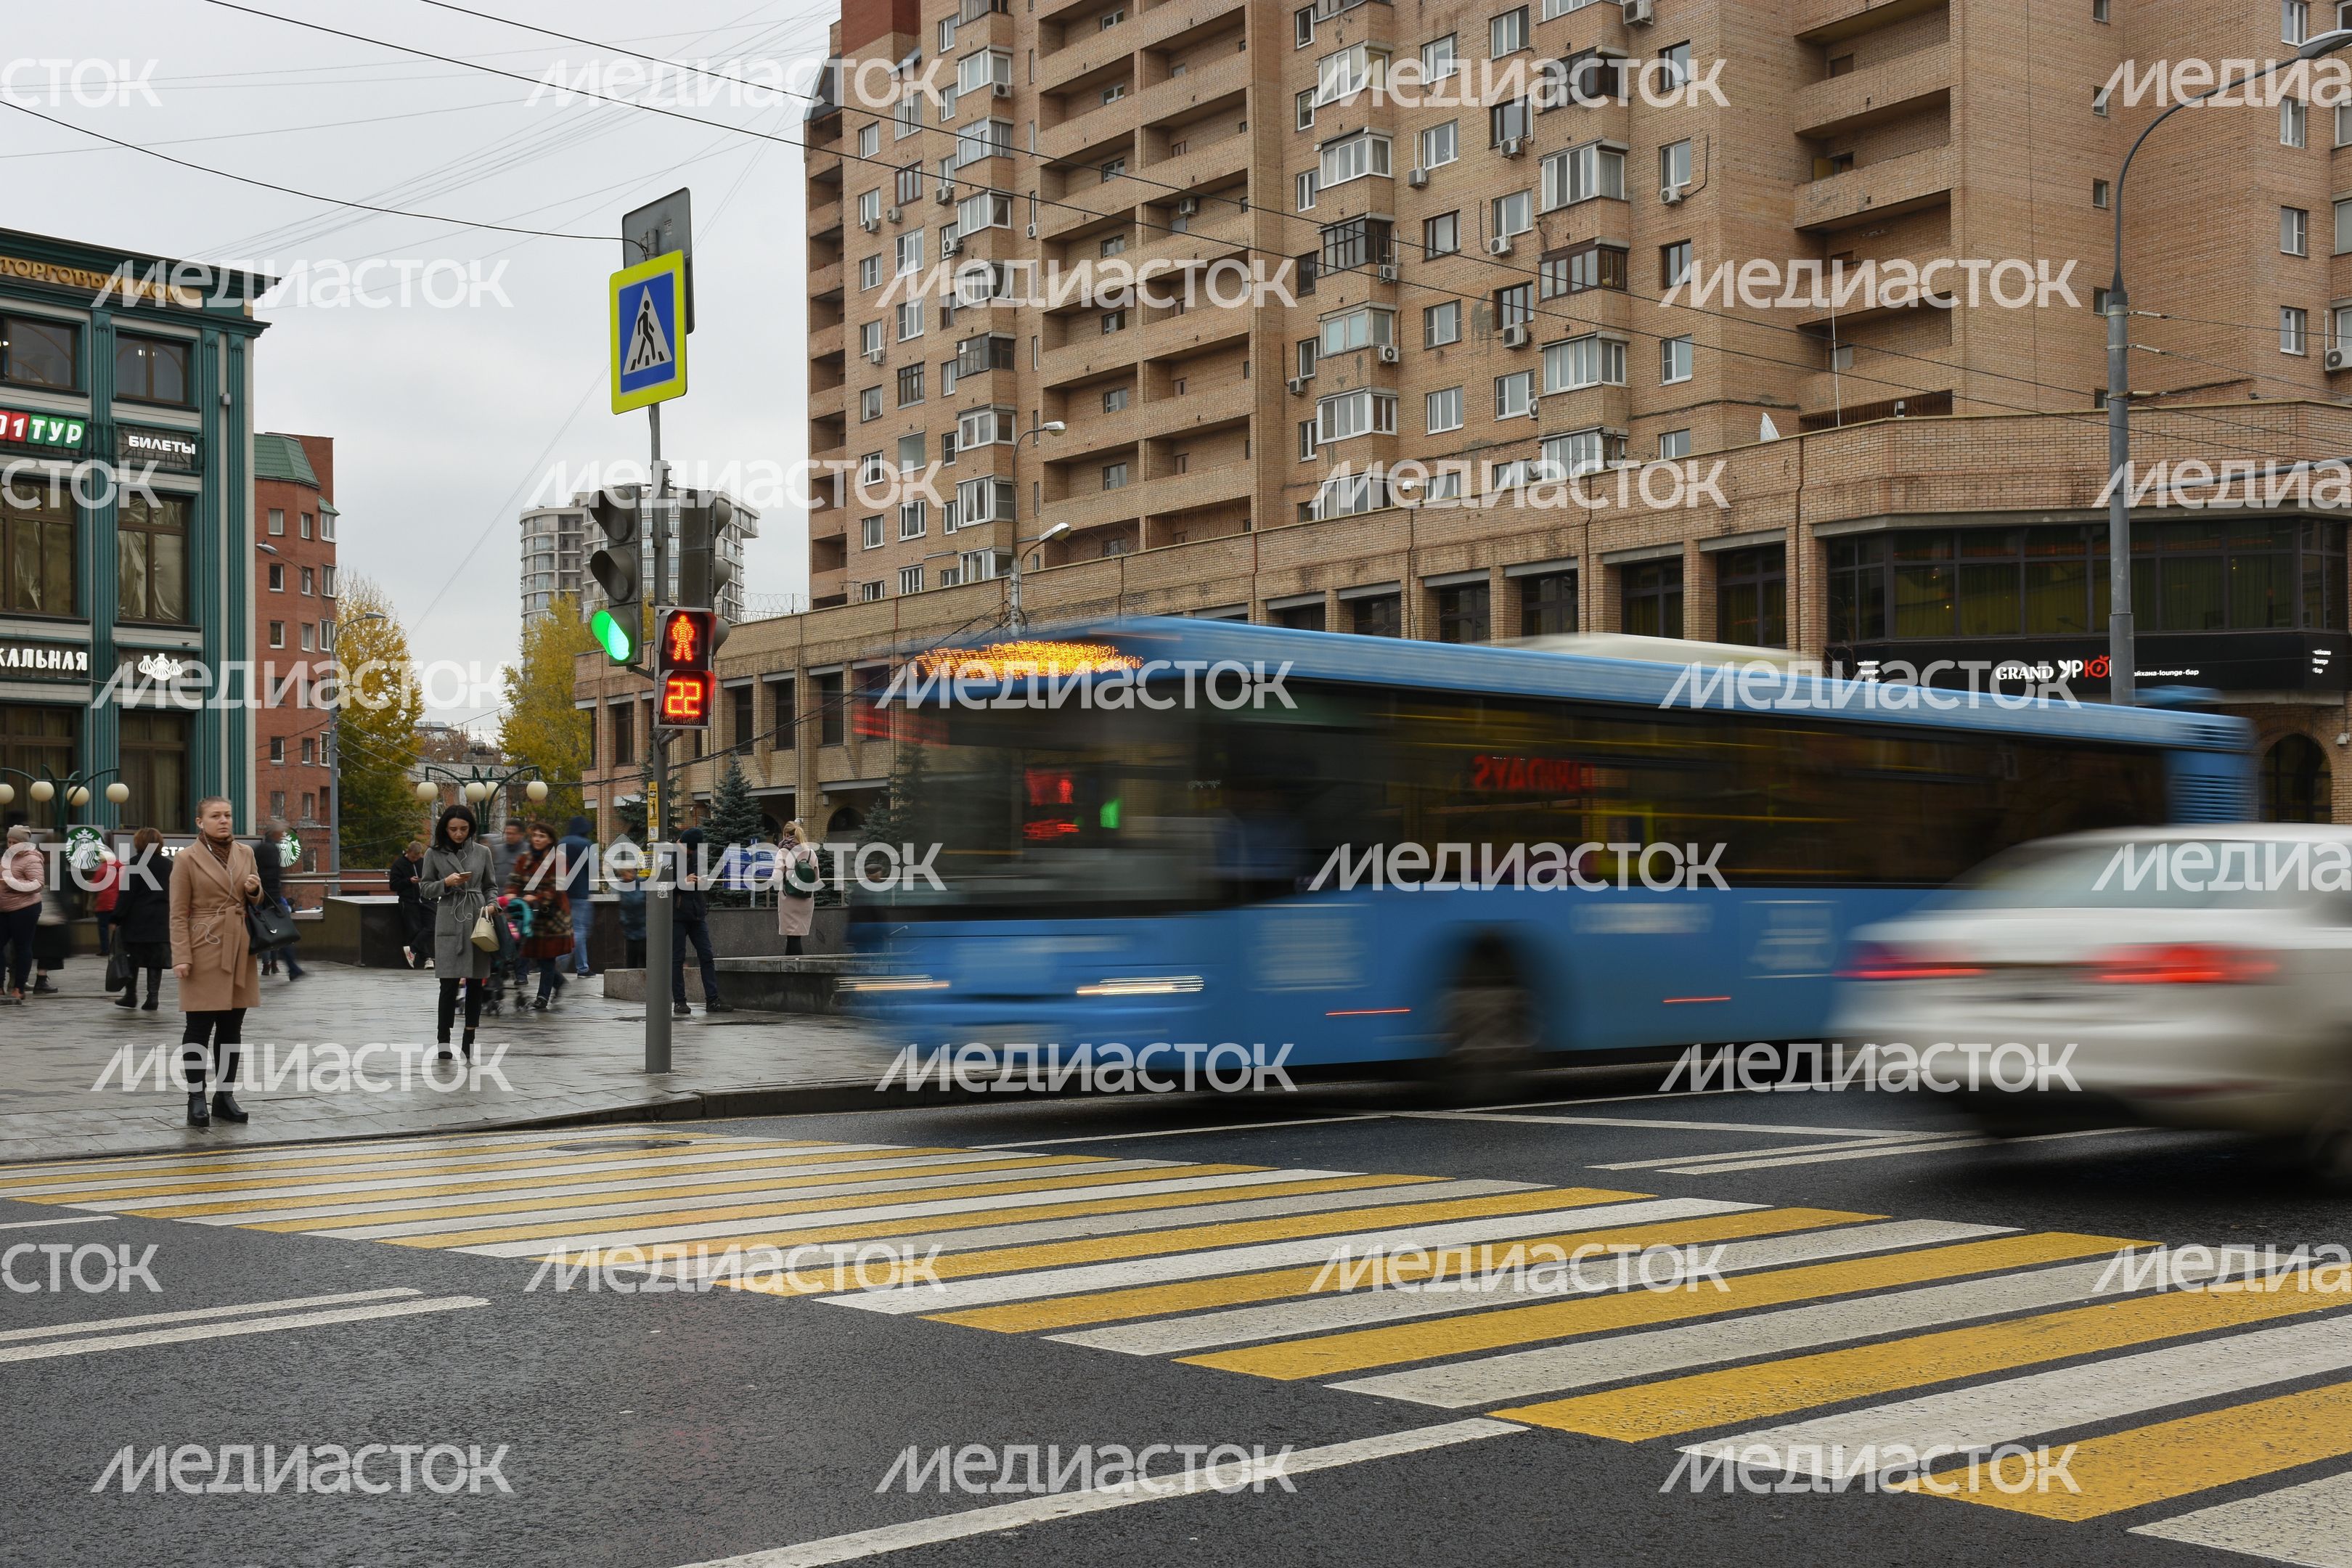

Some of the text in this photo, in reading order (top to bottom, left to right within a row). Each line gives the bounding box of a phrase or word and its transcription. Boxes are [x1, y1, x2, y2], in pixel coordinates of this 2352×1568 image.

[0, 258, 125, 293] ТОРГОВЫЙ
[128, 435, 196, 455] БИЛЕТЫ
[1996, 656, 2112, 680] GRAND УРЮ
[667, 681, 701, 715] 22
